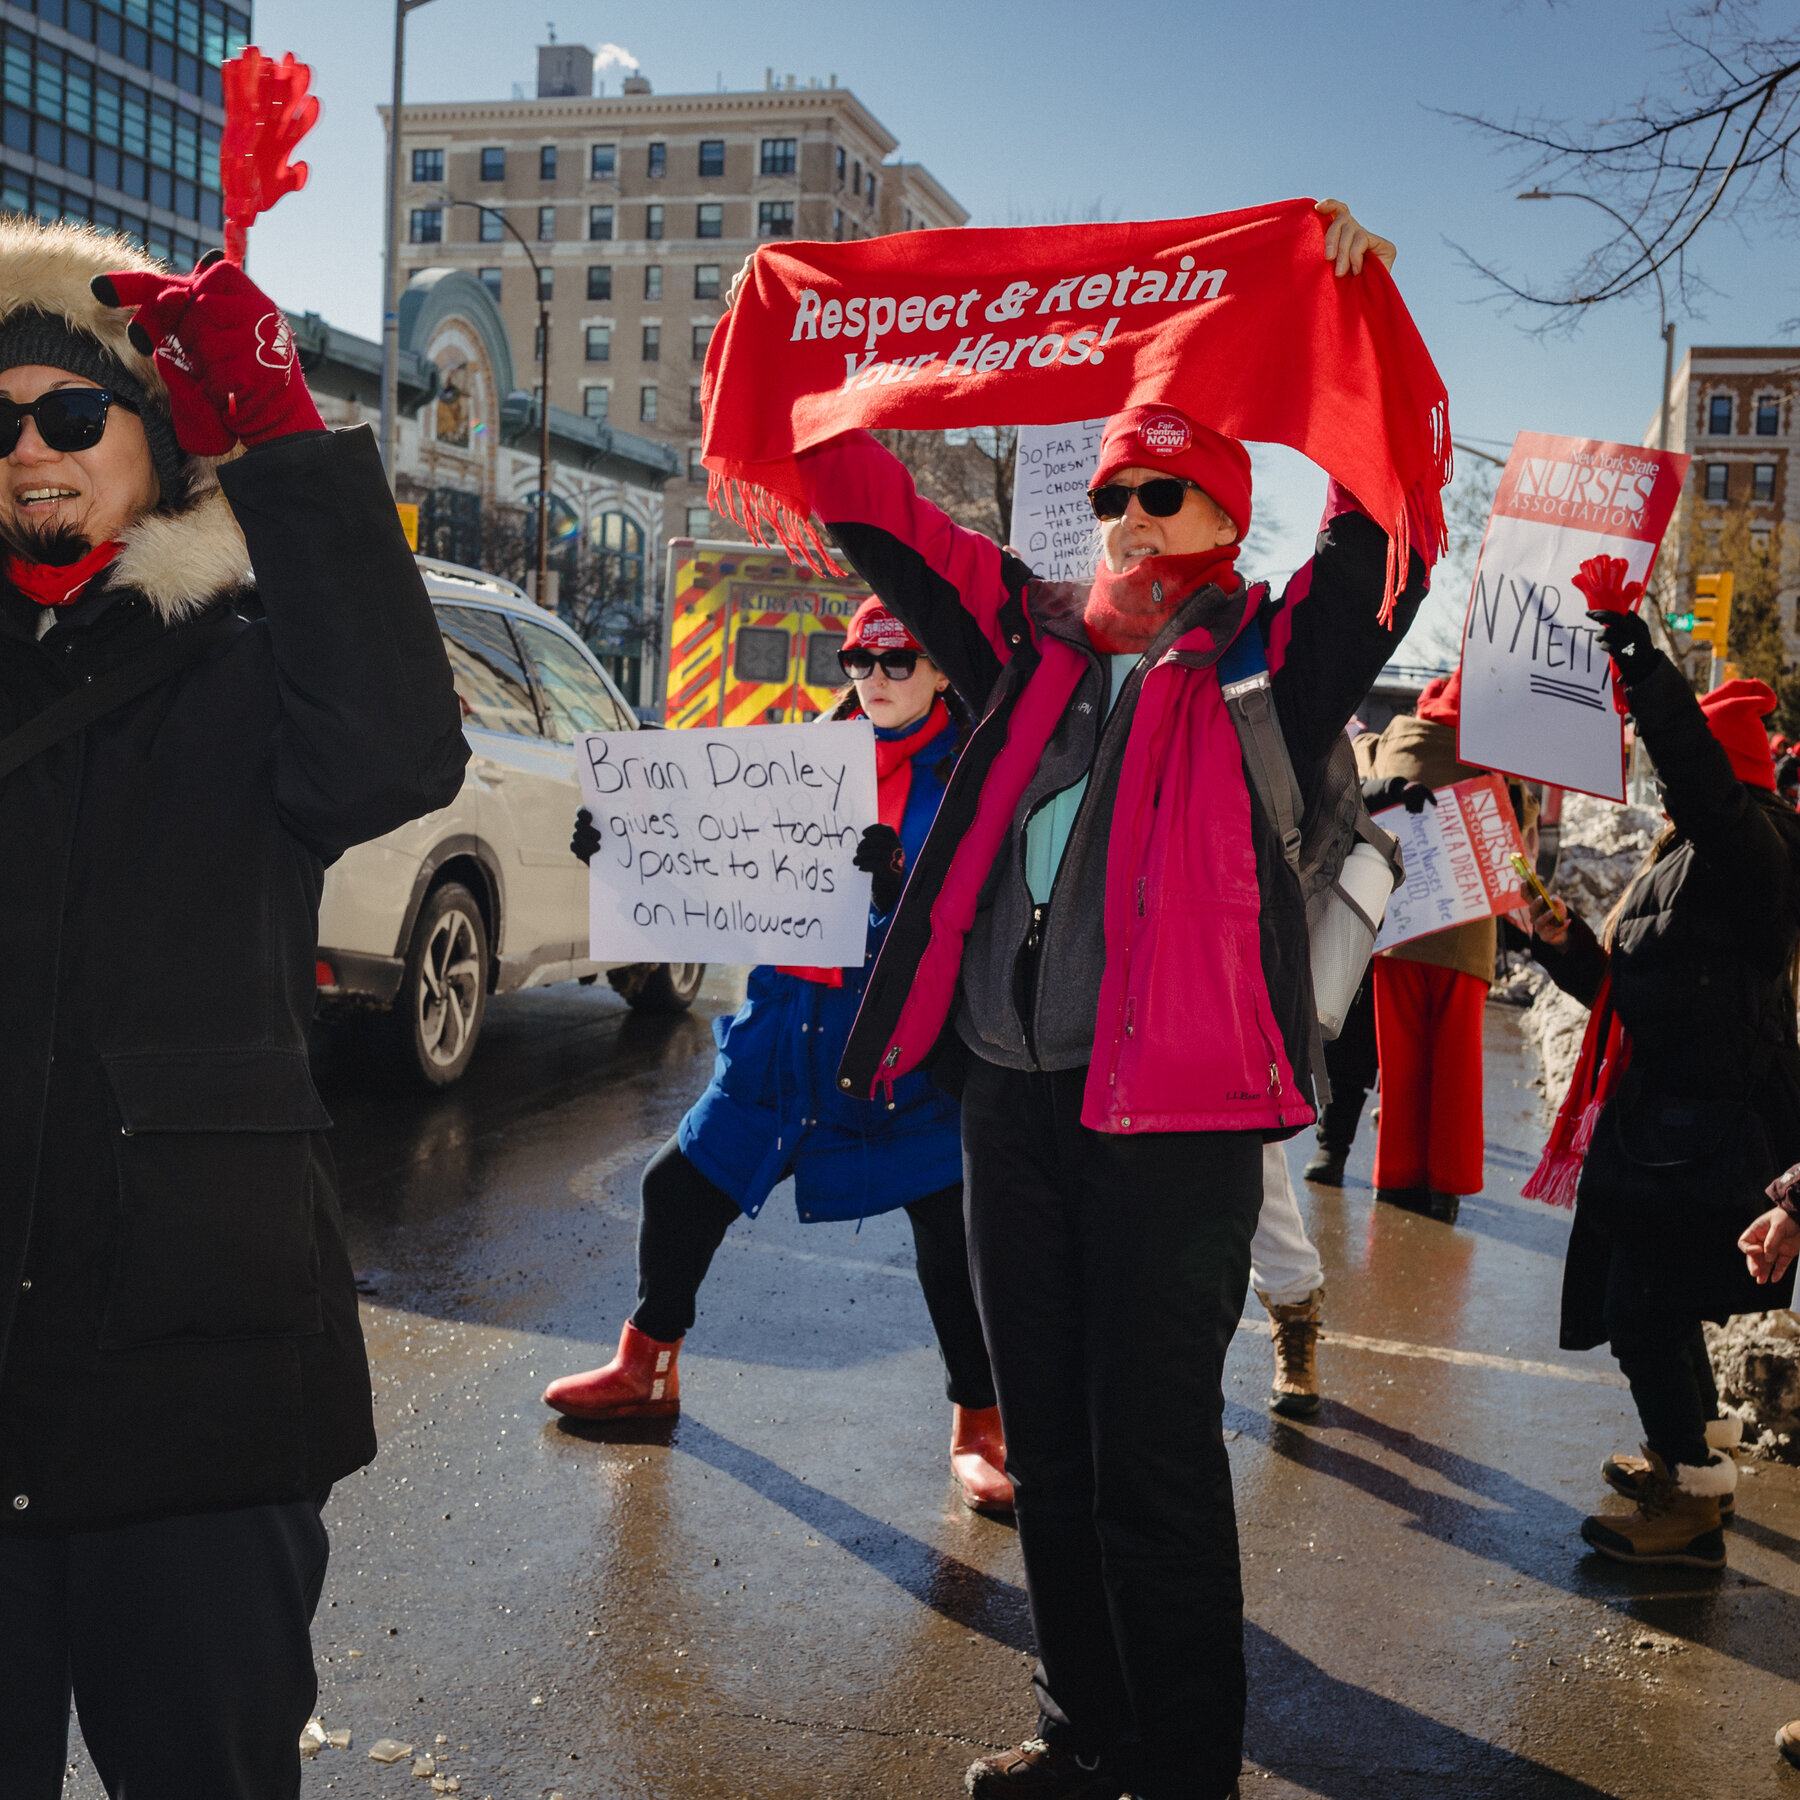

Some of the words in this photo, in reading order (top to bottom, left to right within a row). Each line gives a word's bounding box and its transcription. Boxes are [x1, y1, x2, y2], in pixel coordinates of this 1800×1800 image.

[790, 287, 981, 349] Respect
[985, 281, 1039, 323] &
[1036, 255, 1228, 316] Retain
[837, 350, 939, 395] Your
[938, 318, 1121, 378] Heros!
[1146, 427, 1186, 436] Contract
[1146, 435, 1185, 446] NOW!
[1157, 421, 1175, 429] Fair
[1019, 444, 1043, 466] SO
[1046, 439, 1075, 458] FAR
[1043, 455, 1098, 479] DOESN'T
[1569, 448, 1598, 465] New
[1599, 451, 1627, 471] York
[1626, 455, 1660, 476] State
[1513, 457, 1657, 513] NURSES
[1045, 500, 1092, 519] HATES
[1045, 518, 1073, 530] THE
[1508, 493, 1644, 530] ASSOCIATION
[1468, 570, 1611, 690] NYPETT
[585, 737, 688, 793] Brian
[707, 743, 846, 811] Donley
[610, 812, 679, 868] gives
[774, 808, 859, 849] tooth
[1435, 803, 1465, 840] HAVE
[1445, 841, 1463, 854] A
[1461, 795, 1505, 899] ASSOCIATION
[1470, 788, 1520, 893] NURSES
[639, 849, 718, 885] paste
[729, 851, 759, 879] to
[1419, 846, 1444, 893] Nurses
[1436, 897, 1455, 921] Are
[1450, 853, 1484, 910] DREAM
[633, 901, 675, 926] on
[684, 899, 823, 940] Halloween
